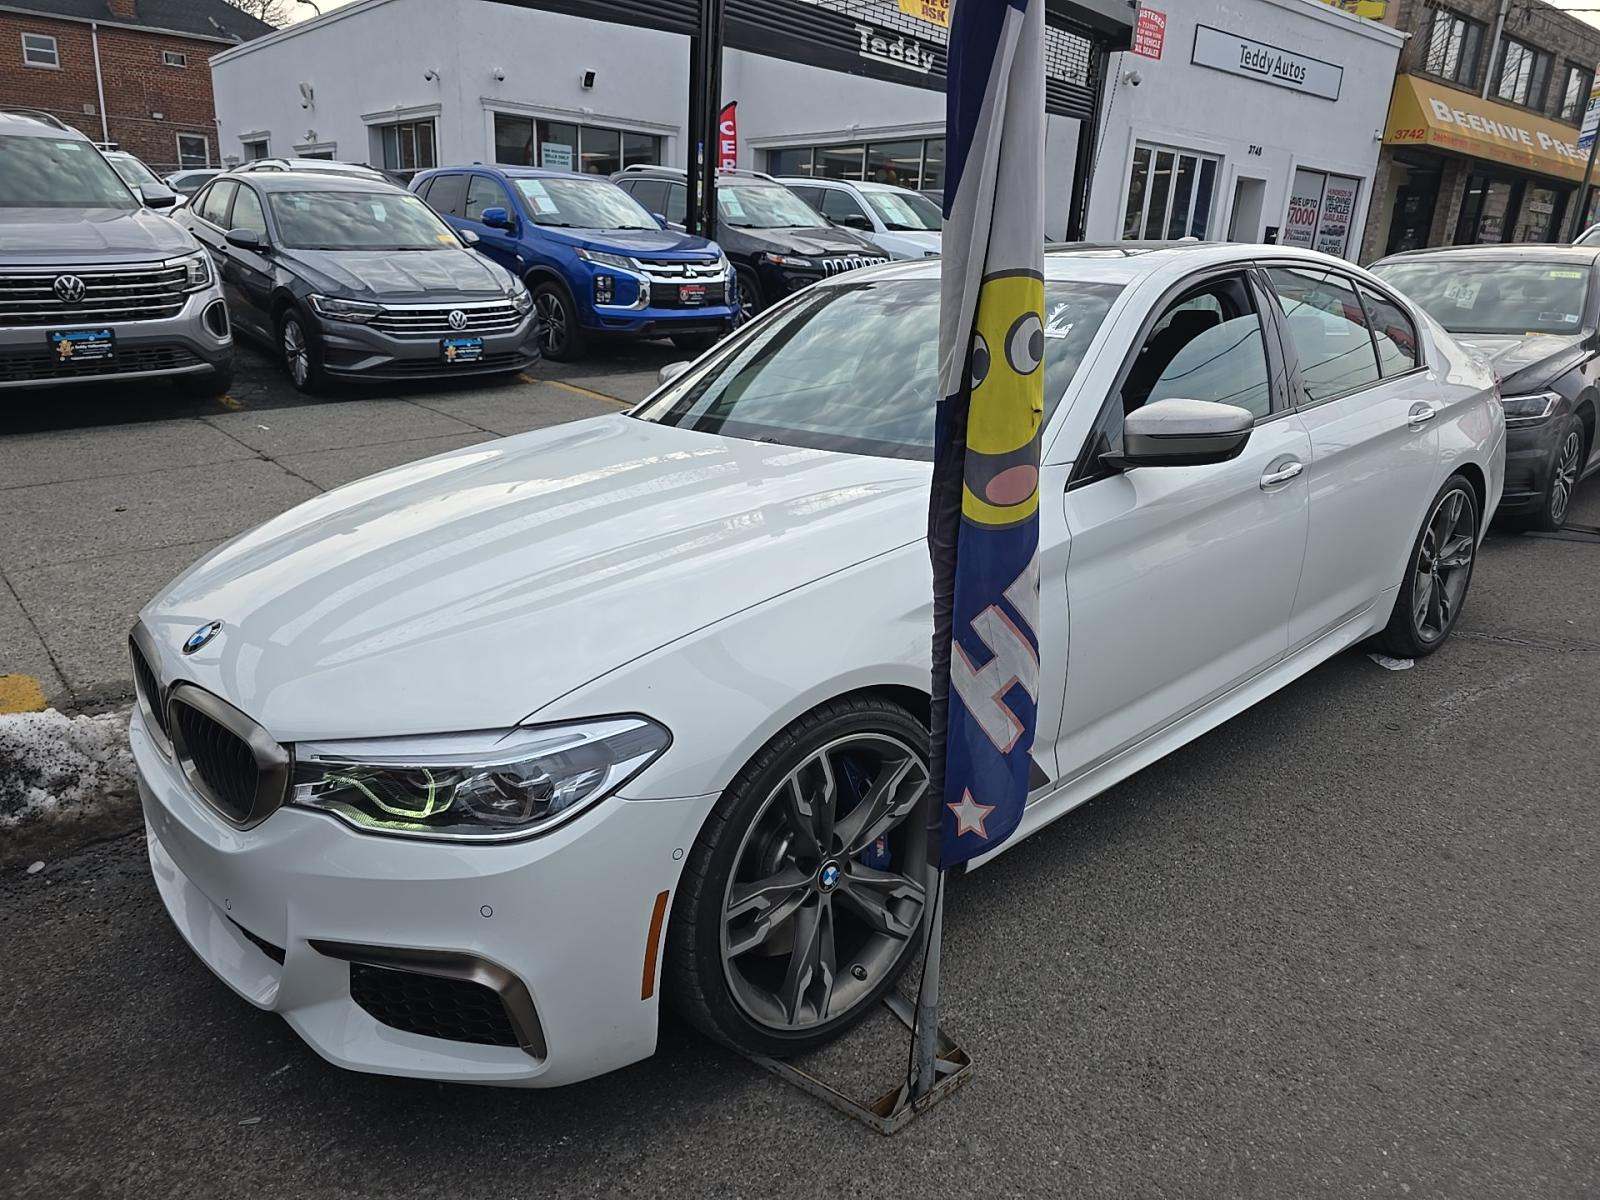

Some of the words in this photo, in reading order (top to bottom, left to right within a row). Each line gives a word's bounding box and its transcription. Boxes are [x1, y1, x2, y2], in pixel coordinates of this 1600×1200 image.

[854, 23, 935, 70] Teddy
[1240, 44, 1274, 74] Teddy
[1274, 55, 1306, 81] Autos
[1394, 128, 1425, 140] 3742
[1429, 97, 1535, 148] BEEHIVE
[1325, 203, 1350, 215] VEHICLES
